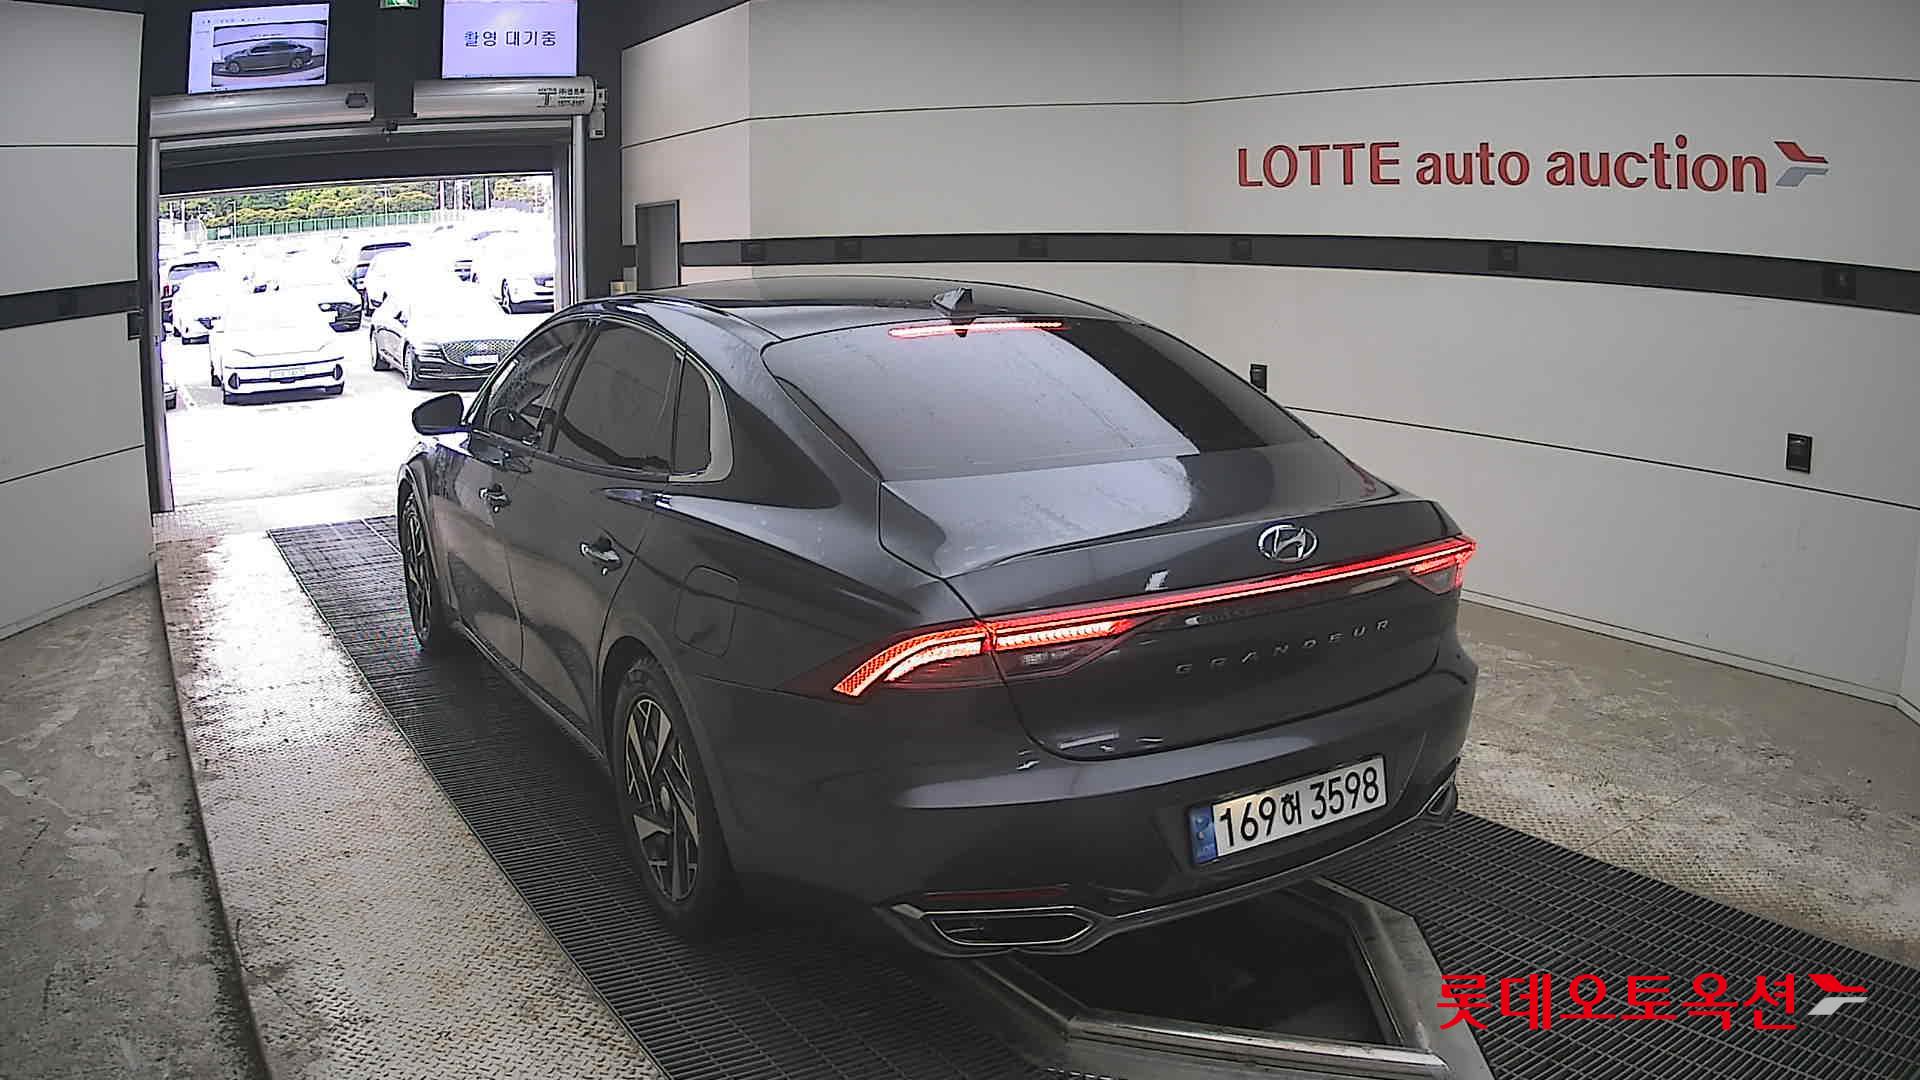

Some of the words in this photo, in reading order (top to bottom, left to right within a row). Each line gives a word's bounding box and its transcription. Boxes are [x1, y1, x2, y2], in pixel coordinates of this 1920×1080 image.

[505, 30, 556, 47] 대기중
[1237, 141, 1401, 187] LOTTE
[1415, 142, 1531, 187] auto
[1545, 134, 1768, 195] auction
[1175, 619, 1390, 673] GRANDEUR
[1219, 790, 1303, 848] 169허
[1309, 766, 1380, 820] 3598
